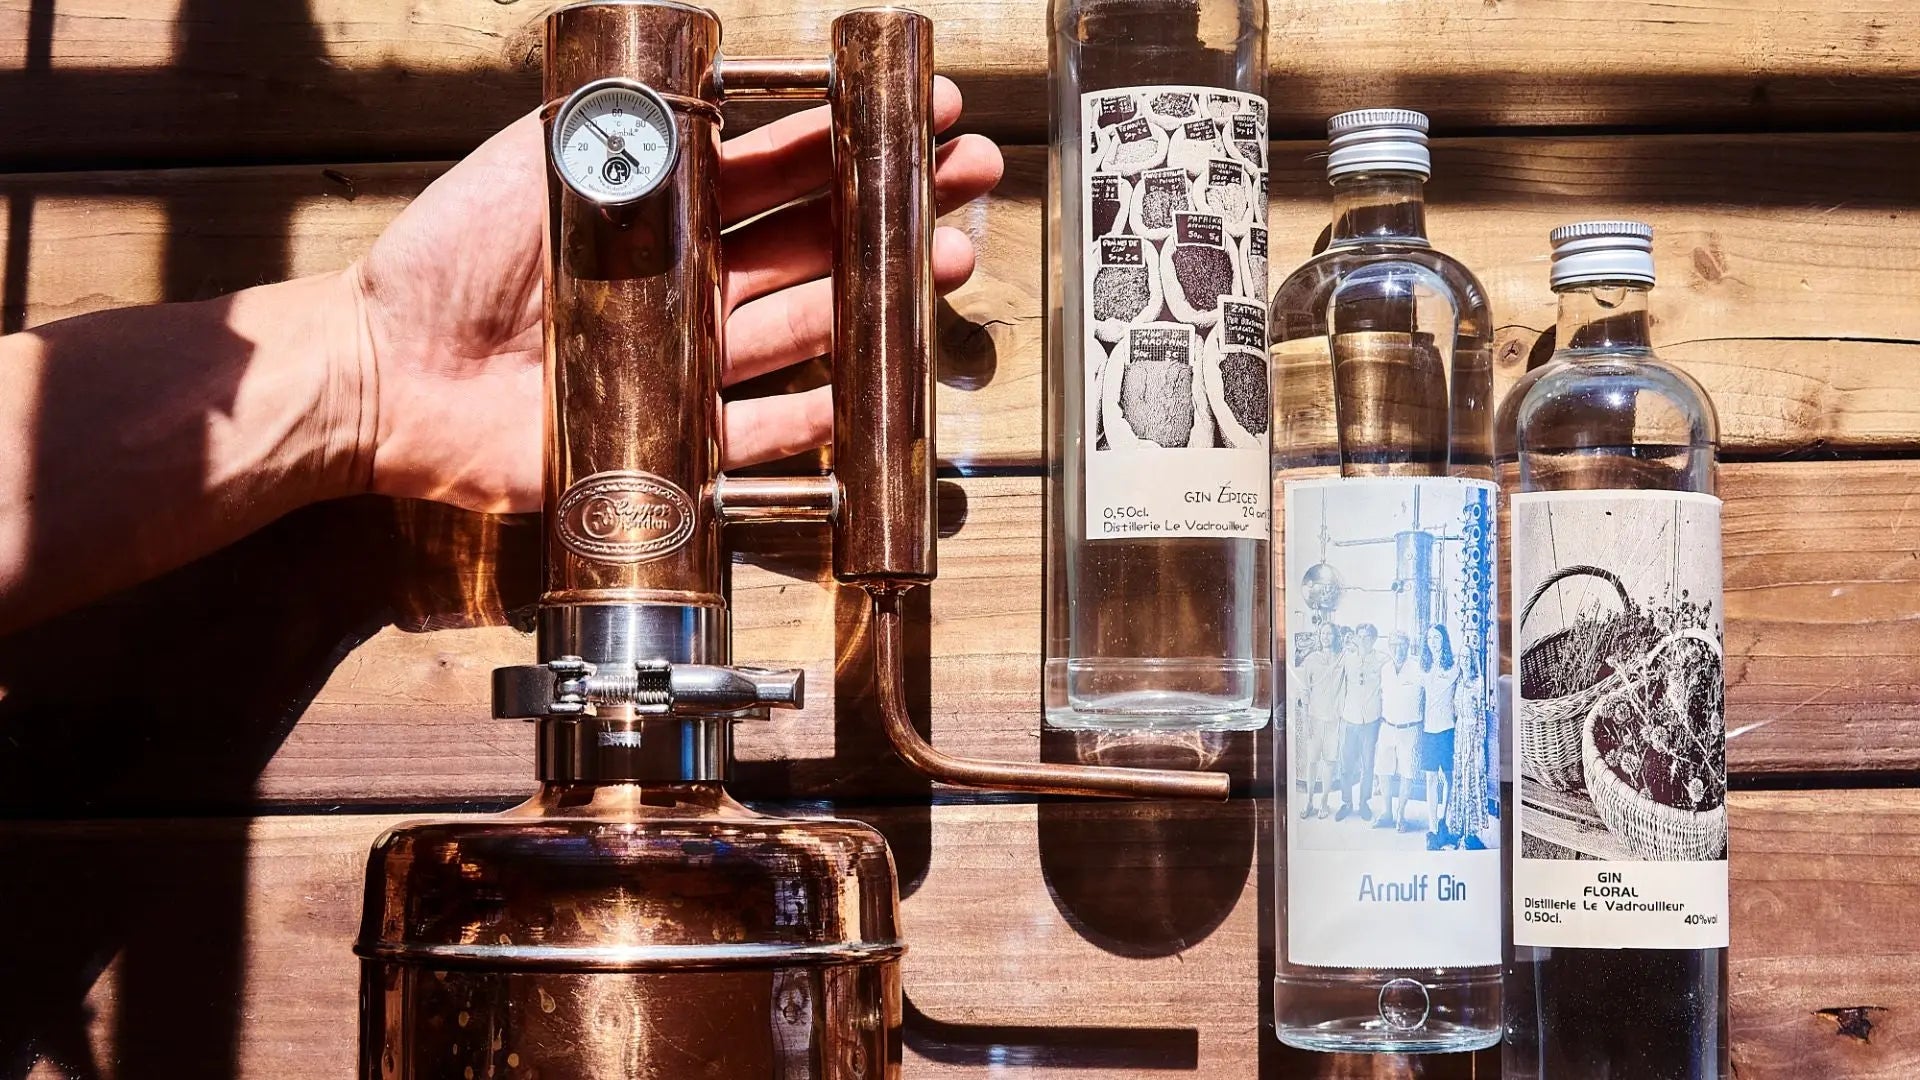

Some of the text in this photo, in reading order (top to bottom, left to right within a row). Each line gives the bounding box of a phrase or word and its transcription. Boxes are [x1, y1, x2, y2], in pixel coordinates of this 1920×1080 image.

[612, 108, 623, 118] 60
[635, 120, 647, 128] 80
[577, 142, 589, 152] 20
[643, 142, 657, 152] 100
[587, 165, 594, 175] 0
[1187, 215, 1222, 225] PAPRIKA
[1184, 480, 1258, 504] GIN ÉPICES
[1242, 506, 1255, 518] 29
[1103, 521, 1161, 533] Distillerie
[1165, 519, 1181, 532] Le
[1185, 519, 1250, 533] Vadrouilleur
[1597, 871, 1622, 884] GIN
[1358, 874, 1466, 902] Arnulf Gin
[1583, 886, 1639, 898] FLORAL
[1524, 897, 1685, 912] Distillerie Le Vadrouilleur
